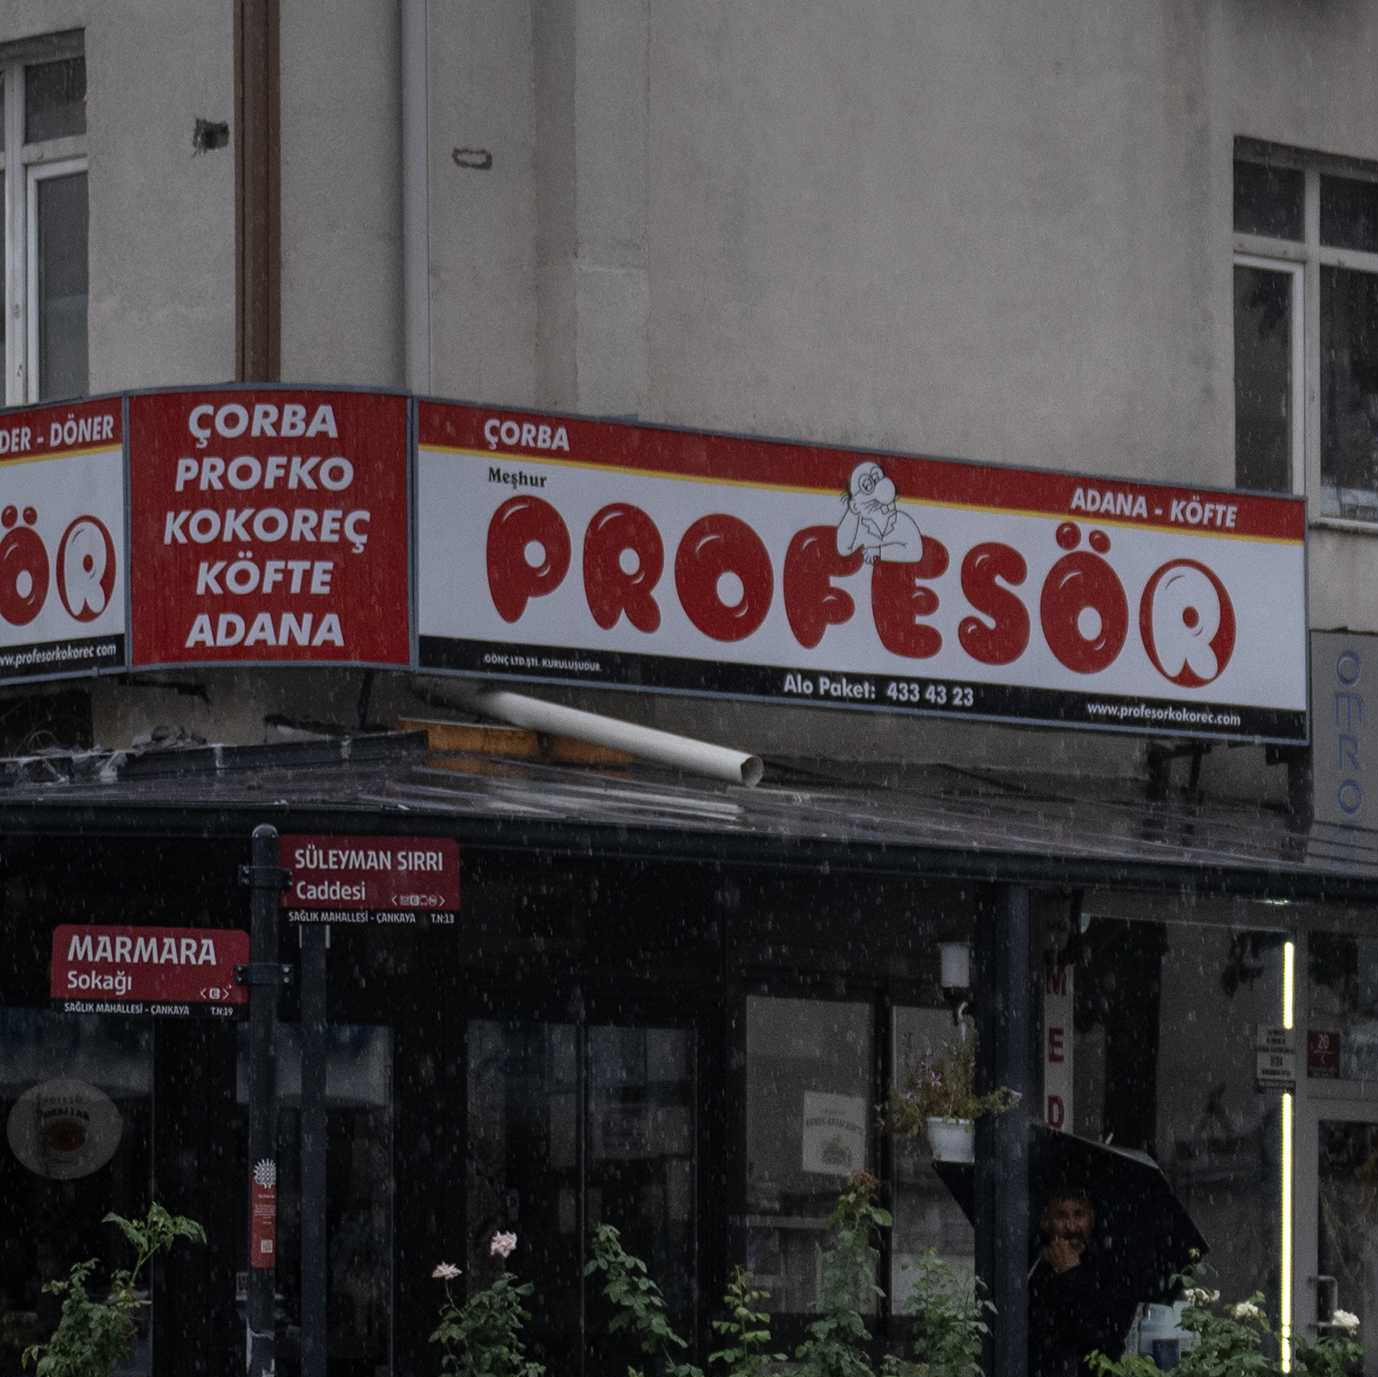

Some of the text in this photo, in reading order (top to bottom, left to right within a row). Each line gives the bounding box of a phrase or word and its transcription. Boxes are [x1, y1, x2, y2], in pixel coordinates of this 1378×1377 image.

[50, 413, 114, 448] DÖNER
[188, 403, 338, 448] ÇORBA
[484, 418, 570, 452] ÇORBA
[175, 456, 354, 492] PROFKO
[487, 467, 547, 490] Meşhur
[1071, 487, 1149, 518] ADANA
[1170, 495, 1238, 528] KÖFTE
[164, 508, 370, 554] KOKOREÇ
[195, 552, 334, 596] KÖFTE
[486, 494, 1237, 688] PROFESÖR
[185, 613, 345, 648] ADANA
[784, 673, 974, 706] Alo Paket: 433 43 23
[1087, 703, 1241, 727] www.profesorkokorec.com
[294, 844, 444, 872] SÜLEYMAN SIRRI
[296, 881, 367, 901] Caddesi
[288, 909, 320, 922] SAĞLIK
[321, 911, 369, 924] MAHALLESİ
[376, 913, 417, 925] ÇANKAYA
[66, 934, 217, 966] MARMARA
[67, 970, 133, 996] Sokağı
[64, 1001, 94, 1014] SAĞLIK
[95, 1002, 143, 1014] MAHALLESİ
[150, 1004, 190, 1017] ÇANKAYA
